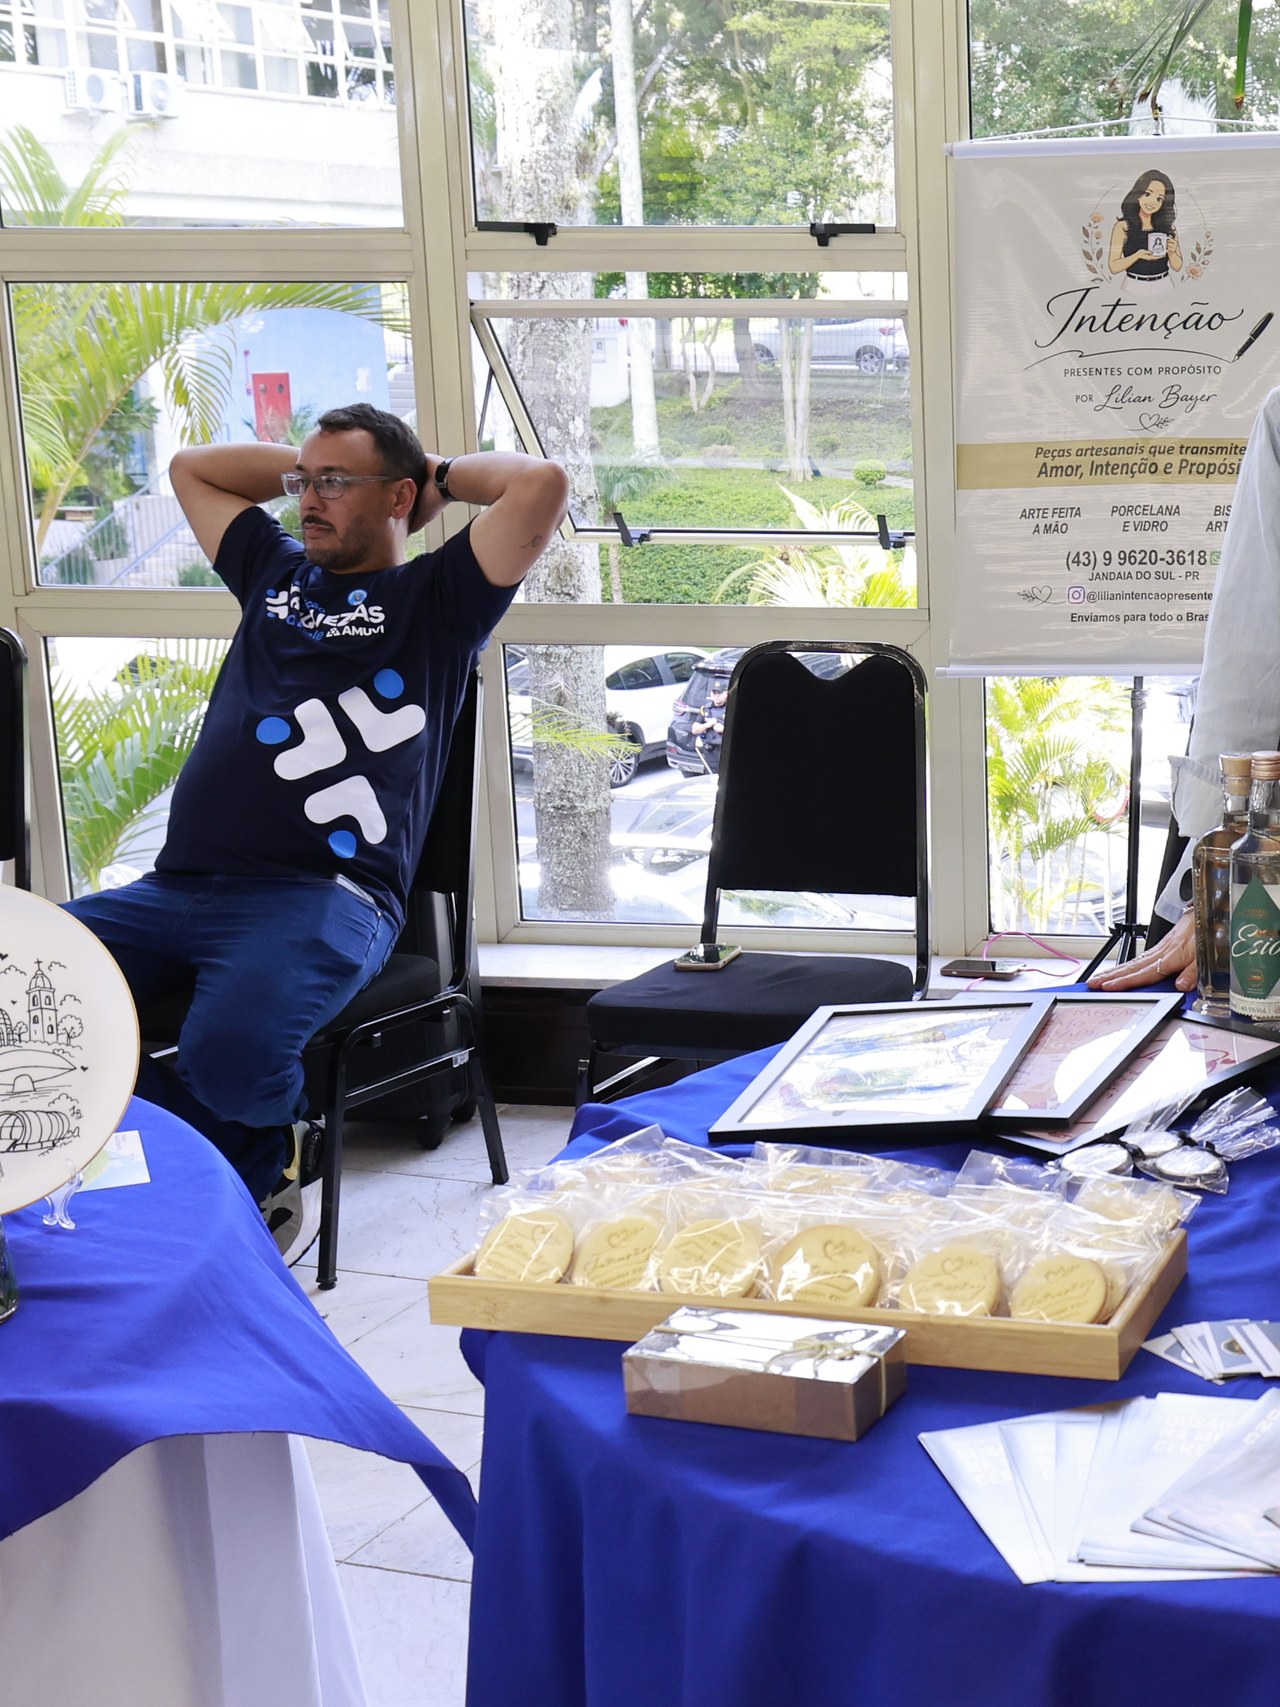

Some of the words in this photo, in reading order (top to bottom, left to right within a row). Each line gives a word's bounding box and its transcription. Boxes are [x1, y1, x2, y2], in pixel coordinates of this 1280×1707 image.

[1034, 286, 1245, 348] Intenção
[1063, 366, 1122, 377] PRESENTES
[1126, 365, 1153, 376] COM
[1158, 363, 1222, 375] PROPÓSITO
[1075, 394, 1094, 403] POR
[1094, 384, 1155, 412] Lilian
[1159, 384, 1218, 413] Bayer
[1034, 446, 1072, 460] Peças
[1075, 443, 1145, 458] artesanais
[1148, 445, 1175, 458] que
[1178, 443, 1247, 456] transmite
[1036, 461, 1085, 479] Amor,
[1088, 457, 1159, 478] Intenção
[1163, 462, 1173, 475] e
[1177, 457, 1242, 478] Propósi
[1019, 507, 1050, 519] ARTE
[1051, 506, 1082, 518] FEITA
[1110, 504, 1181, 517] PORCELANA
[1213, 504, 1232, 516] BIS
[1032, 523, 1042, 534] A
[1042, 521, 1069, 534] MÃO
[1122, 521, 1131, 532] E
[1132, 520, 1168, 532] VIDRO
[1205, 520, 1229, 532] ART
[1065, 551, 1098, 571] (43)
[1102, 552, 1113, 566] 9
[1117, 550, 1208, 567] 9620-3618
[1088, 571, 1134, 581] JANDAIA
[1135, 571, 1152, 581] DO
[1153, 571, 1176, 581] SUL
[1185, 571, 1200, 581] PR
[1086, 590, 1213, 603] @lilianintencaopresente
[1070, 612, 1121, 623] Enviamos
[1123, 613, 1146, 624] para
[1148, 612, 1174, 622] todo
[1175, 614, 1183, 622] o
[1186, 611, 1209, 622] Bras
